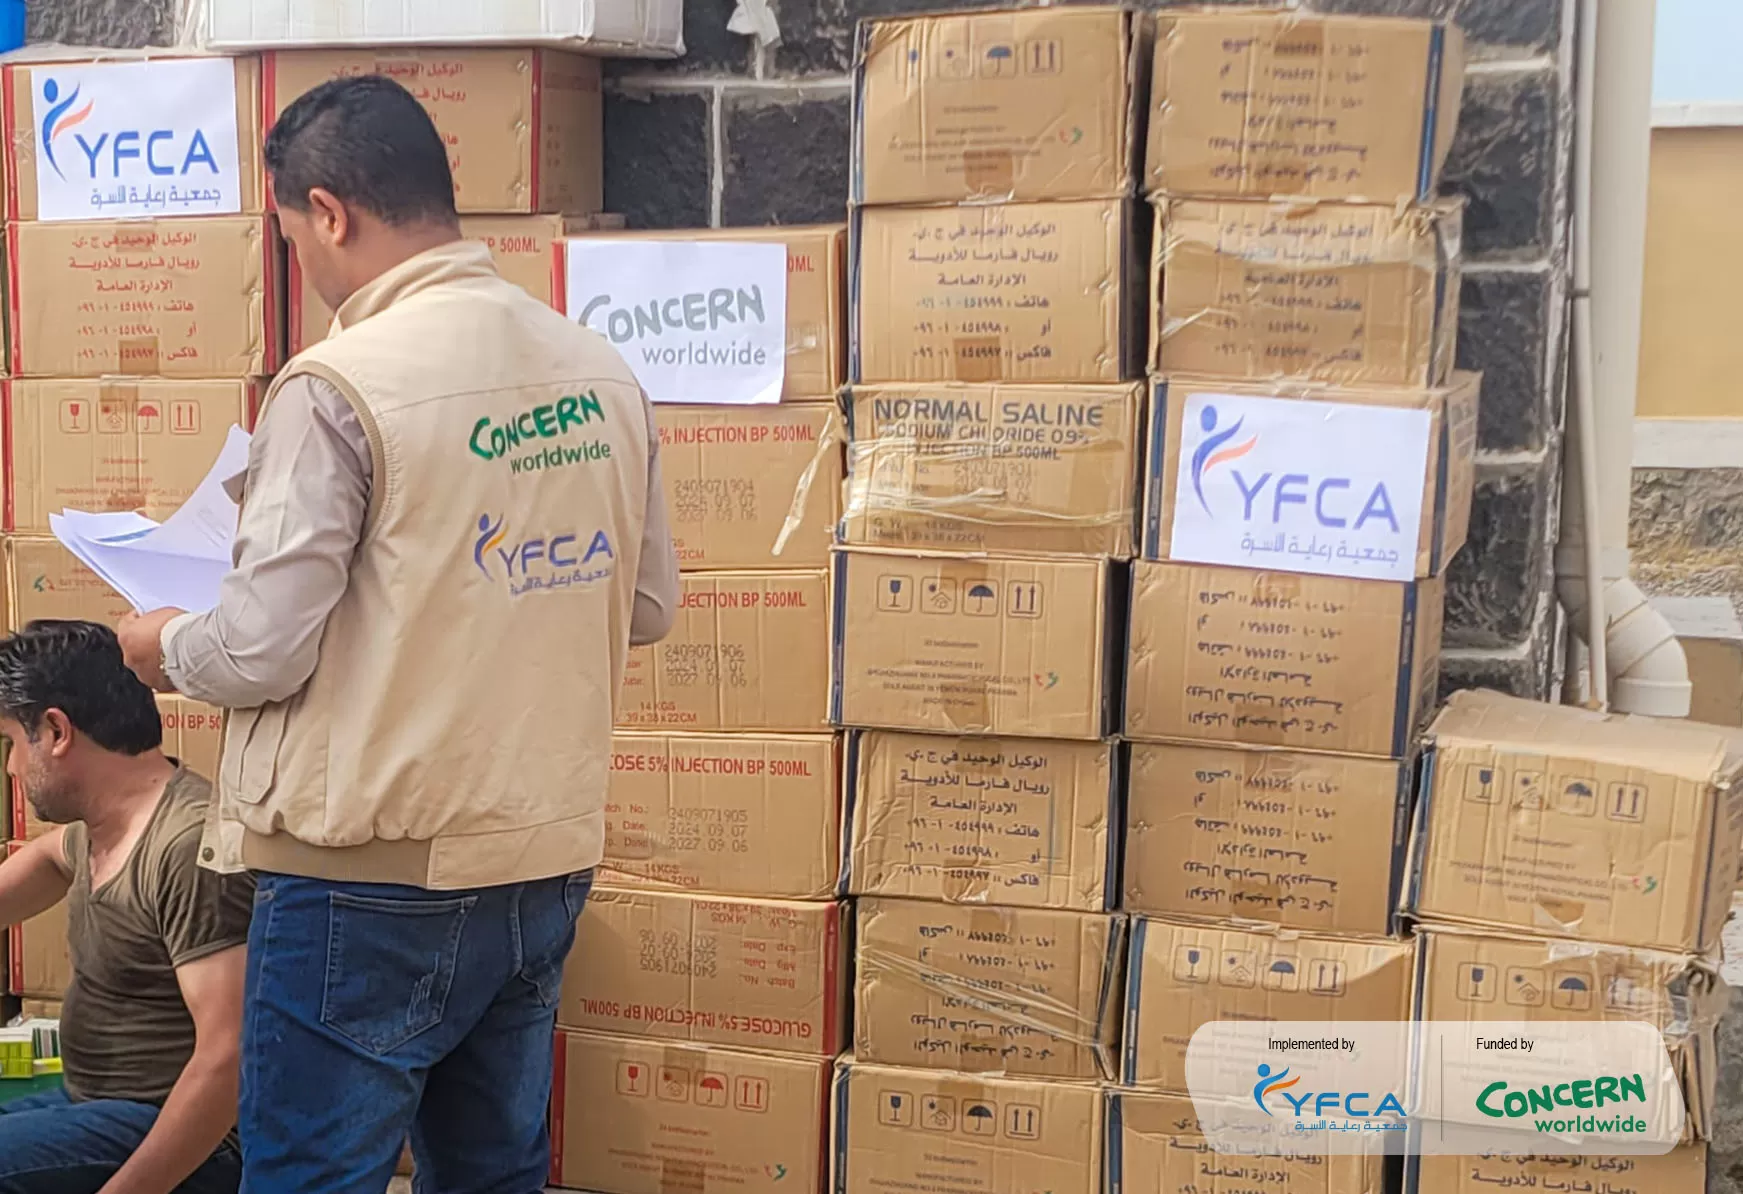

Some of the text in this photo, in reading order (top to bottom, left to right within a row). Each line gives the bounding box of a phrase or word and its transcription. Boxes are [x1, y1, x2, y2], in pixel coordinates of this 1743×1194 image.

[73, 128, 220, 179] YFCA
[129, 184, 166, 209] رعاية
[169, 184, 221, 207] جمعية
[162, 232, 197, 246] الوكيل
[1017, 223, 1056, 238] الوكيل
[500, 236, 541, 253] 500ML
[68, 255, 200, 271] رويال فارما للأدوية
[787, 256, 814, 272] 0ML
[973, 248, 1018, 263] فارما
[1021, 248, 1058, 263] رويال
[163, 299, 194, 311] هاتف
[1014, 295, 1049, 308] هاتف
[578, 285, 766, 344] CONCERN
[167, 347, 198, 361] فاكس
[641, 341, 767, 366] worldwide
[1016, 345, 1051, 361] فاكس
[873, 398, 1104, 427] NORMAL SALINE
[469, 388, 607, 461] CONCERN
[674, 427, 747, 444] INJECTION
[750, 426, 769, 442] BP
[773, 424, 815, 441] 500ML
[510, 440, 611, 475] worldwide
[1017, 445, 1061, 460] 500ML
[1230, 469, 1400, 534] YFCA
[497, 529, 614, 578] YFCA
[1288, 534, 1332, 562] رعاية
[1336, 539, 1399, 568] جمعية
[679, 592, 807, 608] JECTION BP 500ML
[188, 713, 205, 730] BP
[1188, 711, 1228, 728] الوكيل
[649, 755, 669, 772] 5%
[671, 757, 743, 775] INJECTION
[747, 759, 765, 775] BP
[770, 760, 811, 776] 500ML
[941, 750, 1048, 770] الوكيل الوحيد في
[901, 769, 1049, 795] رويال فارما للأدوية
[930, 796, 976, 810] العامة
[1005, 824, 1040, 837] هاتف
[1031, 848, 1040, 863] أو
[1004, 874, 1040, 887] فاكس
[1186, 886, 1225, 904] الوكيل
[580, 998, 812, 1039] GLUCOSE 5% INJECTION BP 500ML
[914, 1038, 951, 1055] الوكيل
[1201, 1162, 1248, 1178] العامة
[1592, 1157, 1634, 1173] الوكيل
[1471, 1168, 1537, 1187] للأدوية
[1542, 1177, 1592, 1193] فارما
